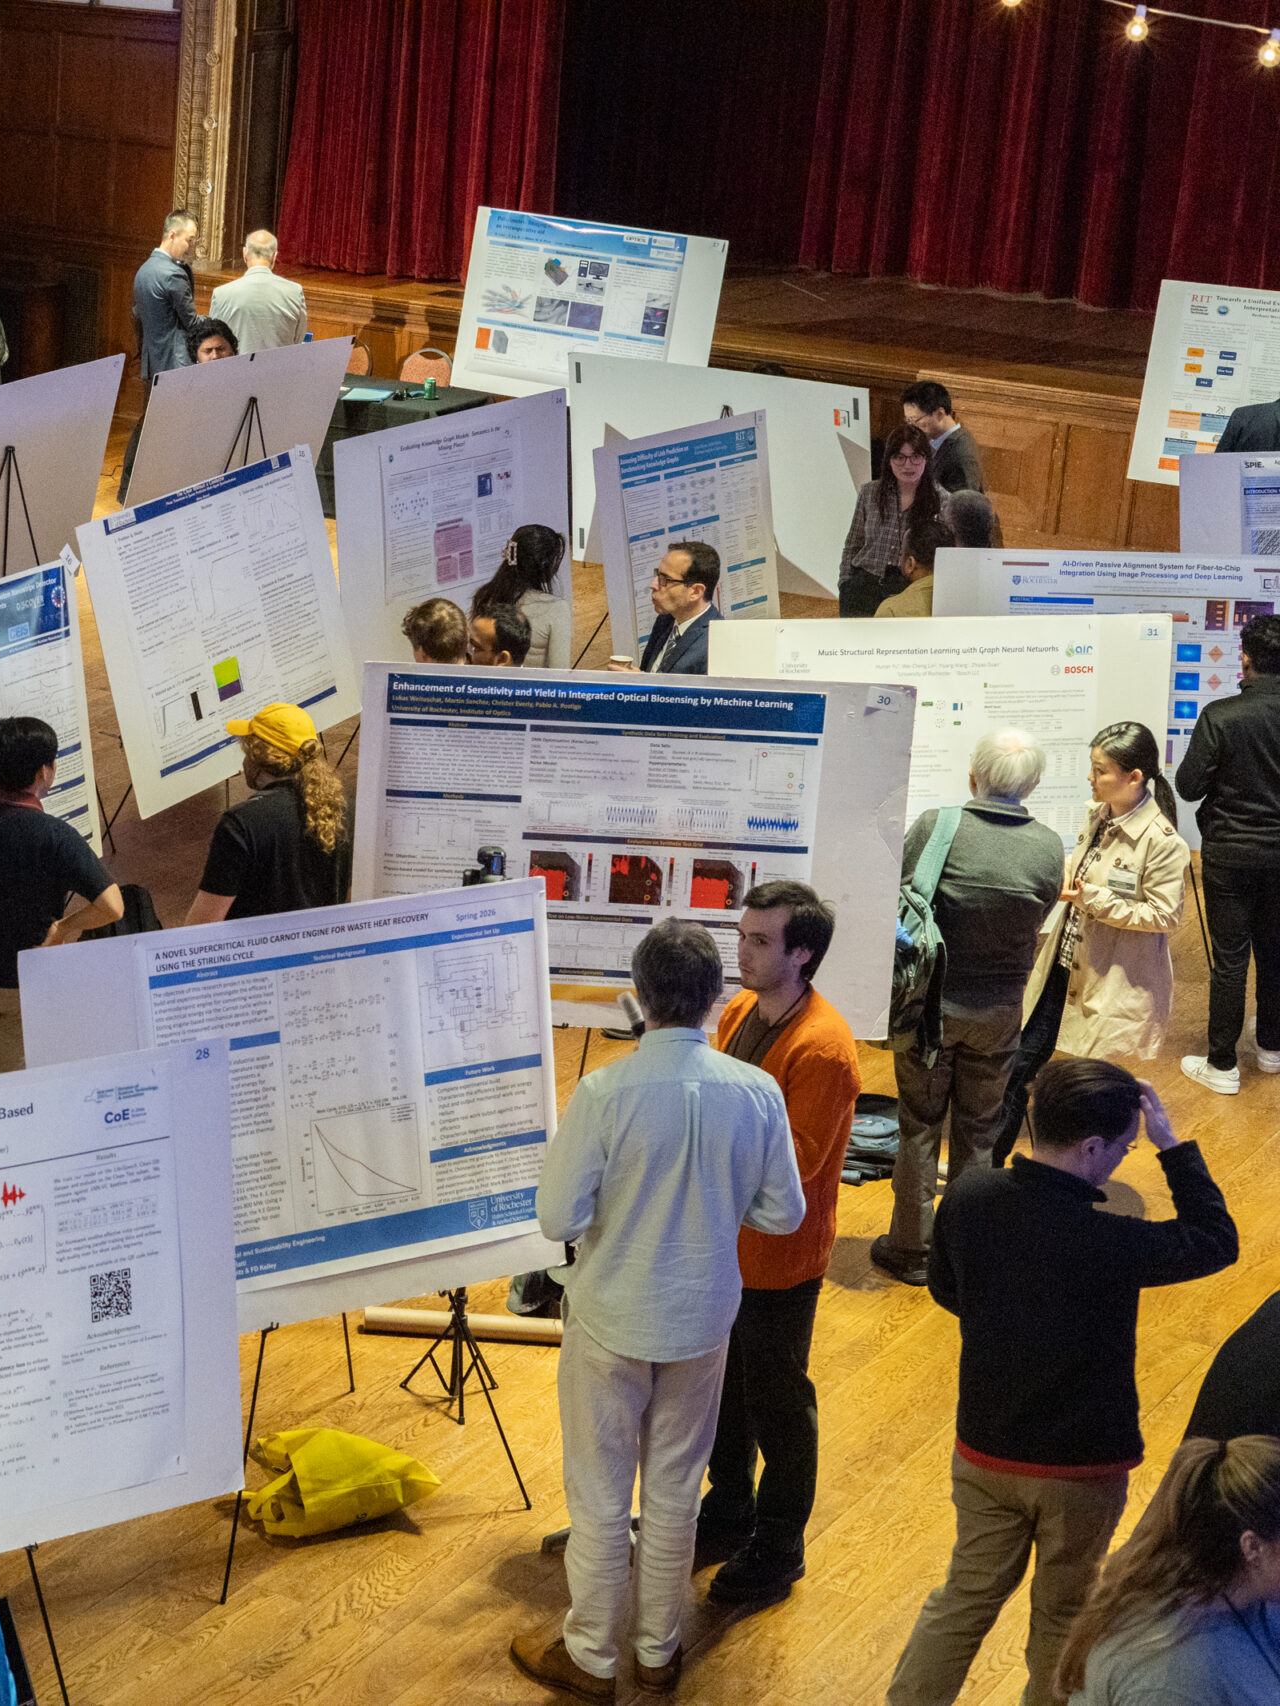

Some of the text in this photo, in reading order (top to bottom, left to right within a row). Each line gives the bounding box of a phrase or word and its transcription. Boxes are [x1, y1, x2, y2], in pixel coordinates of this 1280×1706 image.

[1191, 294, 1212, 303] RIT
[1062, 560, 1093, 568] AI-Driven
[1095, 561, 1122, 569] Passive
[1123, 561, 1158, 571] Alignment
[1159, 563, 1183, 572] System
[1196, 564, 1241, 573] Fiber-to-Chip
[1059, 569, 1243, 583] Integration Using Image Processing and Deep Learning
[1147, 628, 1158, 636] 31
[818, 645, 1059, 657] Music Structural Representation Learning with Graph Neural Networks
[1064, 666, 1094, 674] BOSCH
[392, 681, 794, 711] Enhancement of Sensitivity and Yield in Integrated Optical Biosensing by Machine Learning
[877, 696, 891, 706] 30
[456, 909, 496, 924] Spring 2026
[155, 912, 429, 960] A NOVEL SUPERCRITICAL FLUID CARNOT ENGINE FOR WASTE HEAT RECOVERY
[155, 951, 254, 973] USING THE STIRLING CYCLE
[195, 1048, 210, 1060] 28
[104, 1108, 130, 1124] CoE
[96, 1152, 117, 1161] Results
[100, 1360, 130, 1372] References
